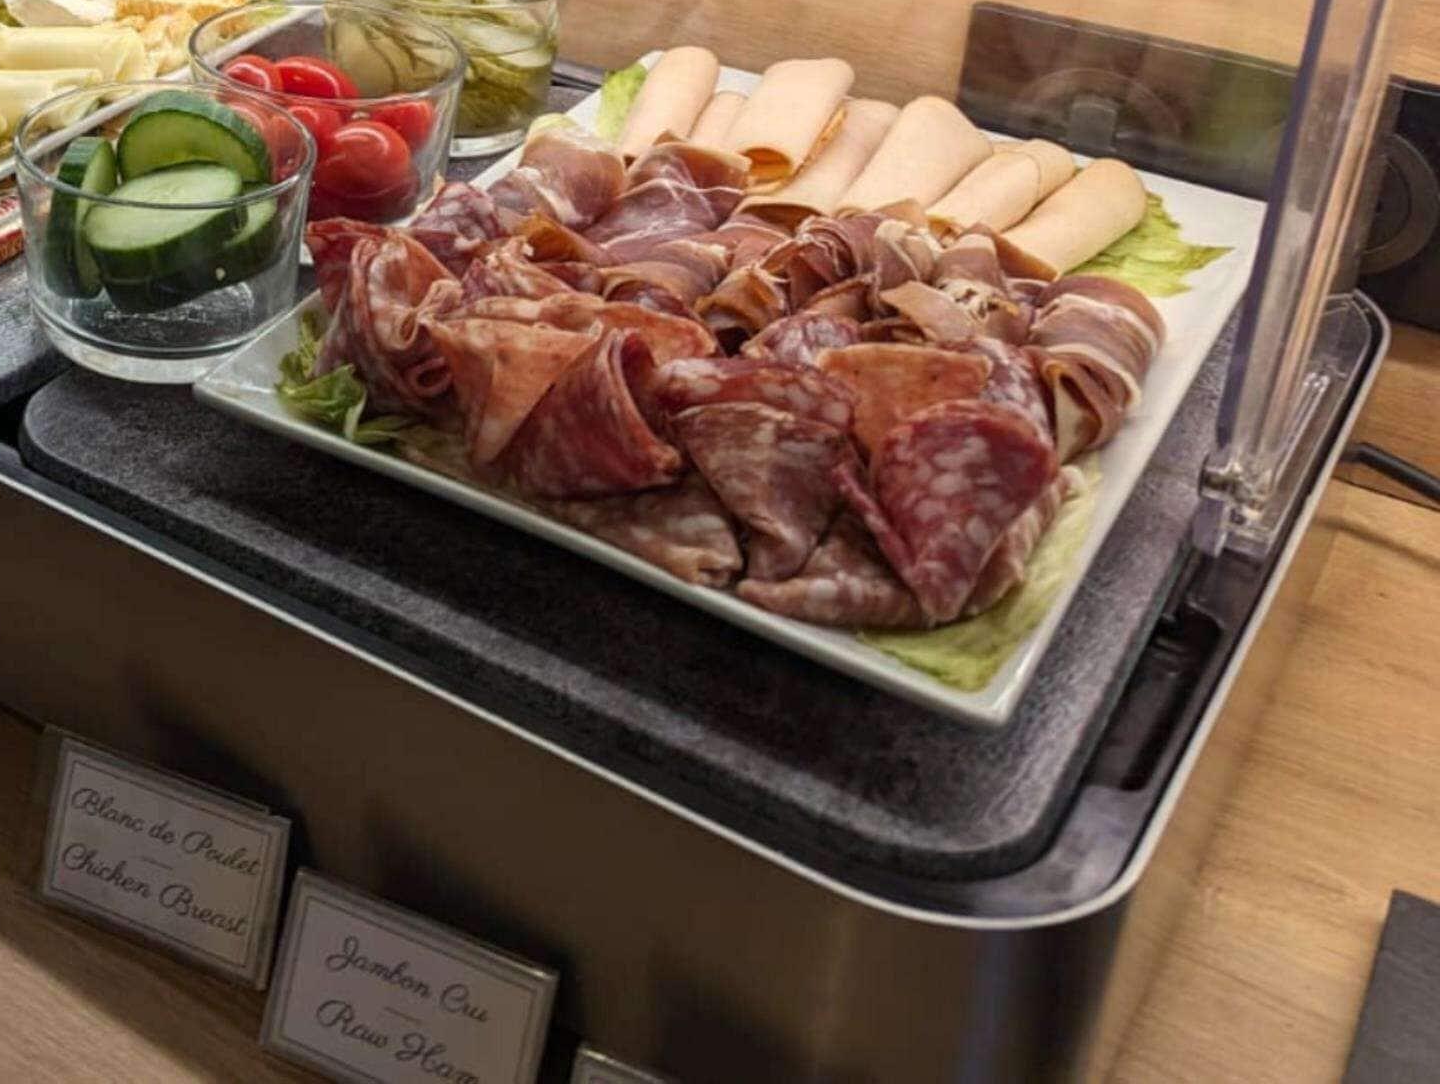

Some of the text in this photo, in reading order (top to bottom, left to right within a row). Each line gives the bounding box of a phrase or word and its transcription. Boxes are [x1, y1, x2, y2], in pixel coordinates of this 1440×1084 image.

[70, 787, 260, 877] Blanc de Poulet
[61, 841, 248, 936] Chicken Breast
[324, 935, 489, 1023] Jambon Cru
[315, 999, 481, 1084] Raw Ham
